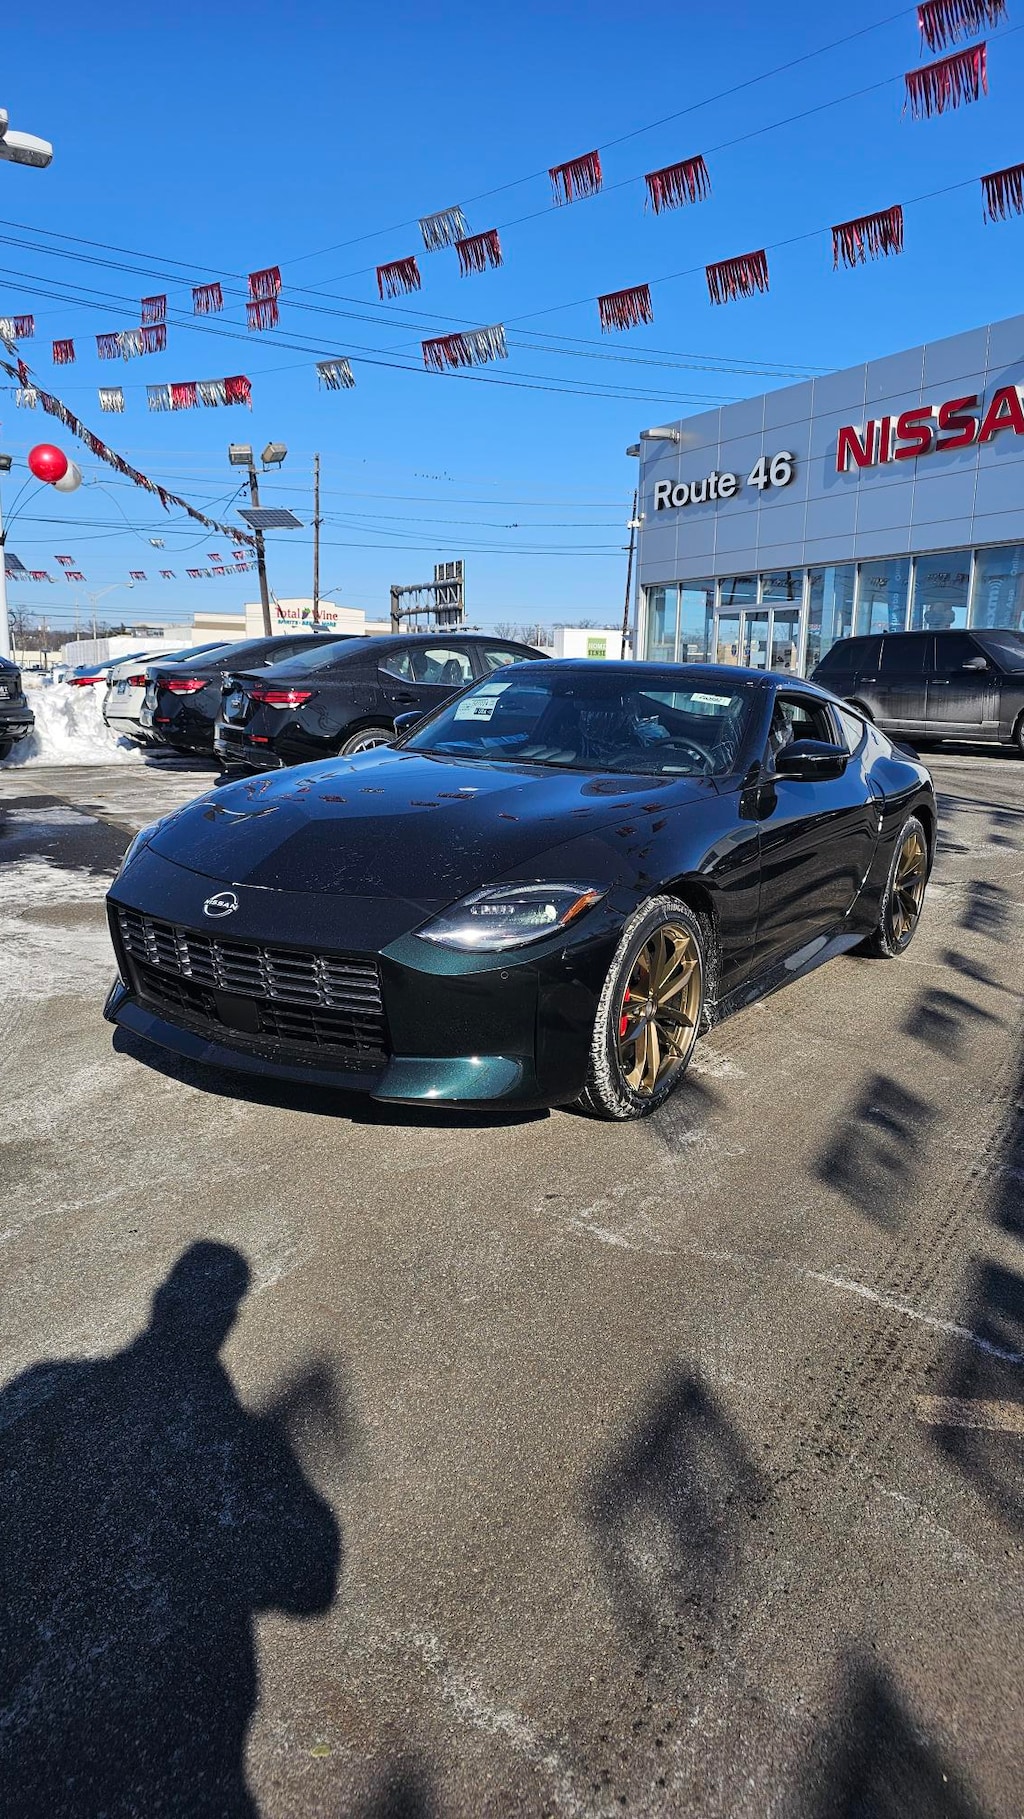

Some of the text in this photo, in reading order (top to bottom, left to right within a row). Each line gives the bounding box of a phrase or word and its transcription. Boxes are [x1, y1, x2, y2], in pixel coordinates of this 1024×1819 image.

[654, 450, 793, 510] Route 46
[275, 607, 338, 620] Total Wine
[203, 899, 239, 911] NISSAN
